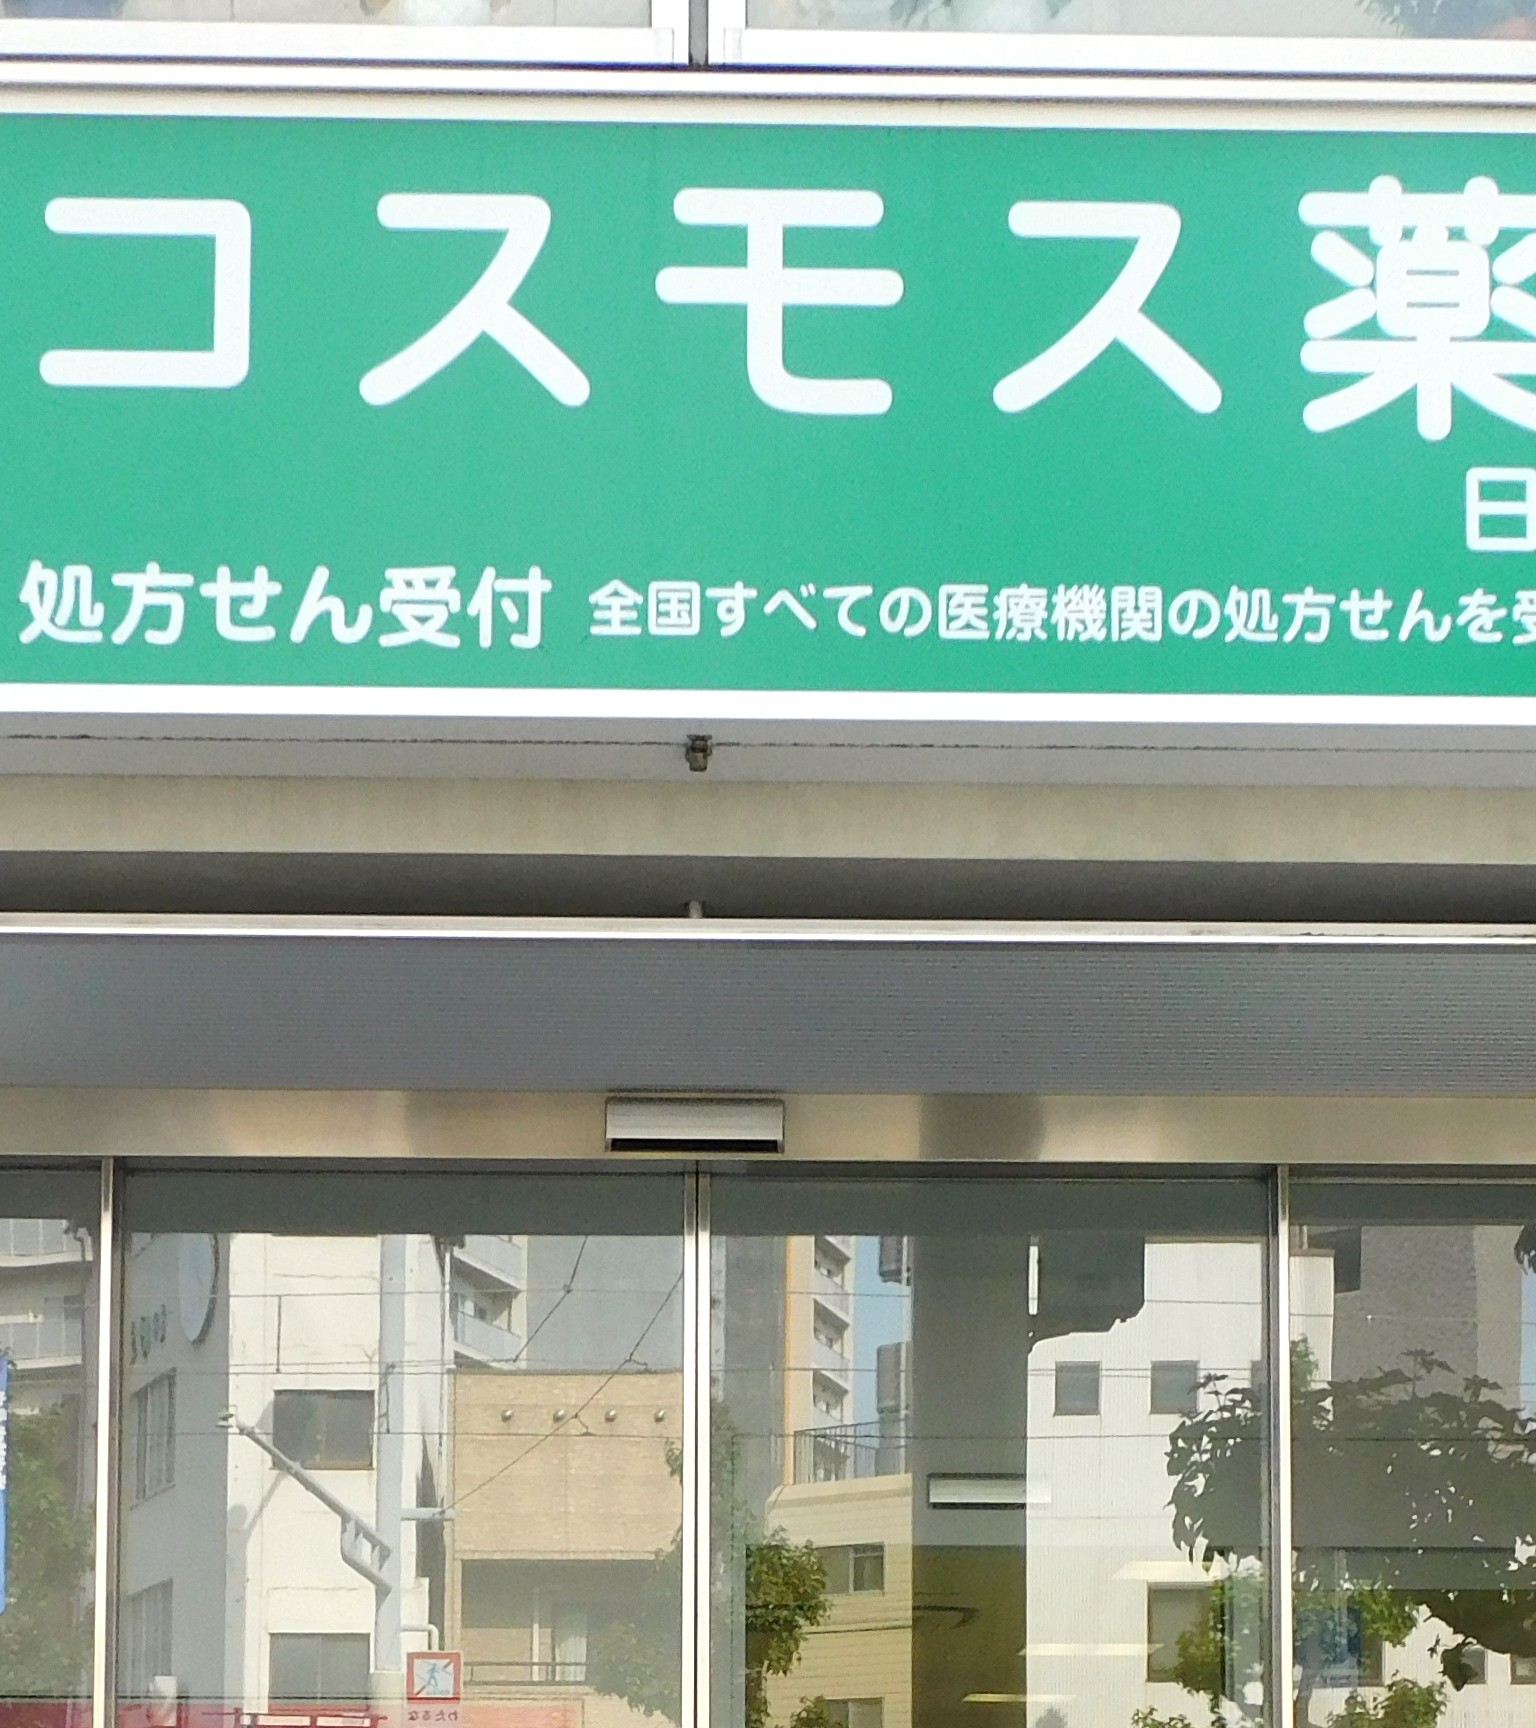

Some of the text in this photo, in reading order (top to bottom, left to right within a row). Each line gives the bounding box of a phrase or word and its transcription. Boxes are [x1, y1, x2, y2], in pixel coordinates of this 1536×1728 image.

[19, 560, 551, 649] 処方せん受付
